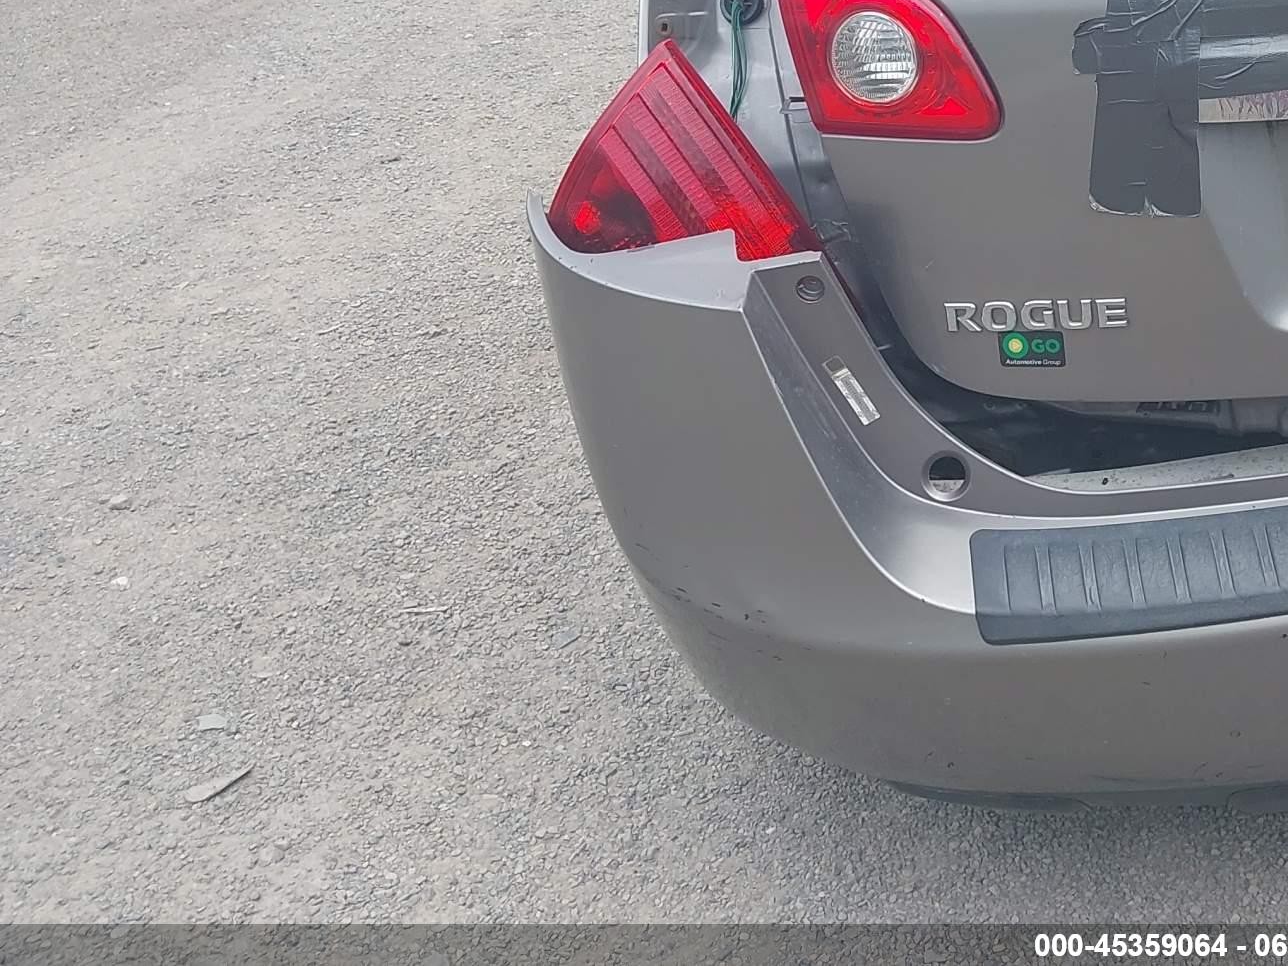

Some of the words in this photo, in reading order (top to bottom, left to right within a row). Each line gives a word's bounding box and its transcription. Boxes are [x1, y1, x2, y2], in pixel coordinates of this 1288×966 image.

[943, 297, 1129, 333] ROGUE
[1031, 338, 1061, 354] GO
[1005, 358, 1042, 366] Automotive
